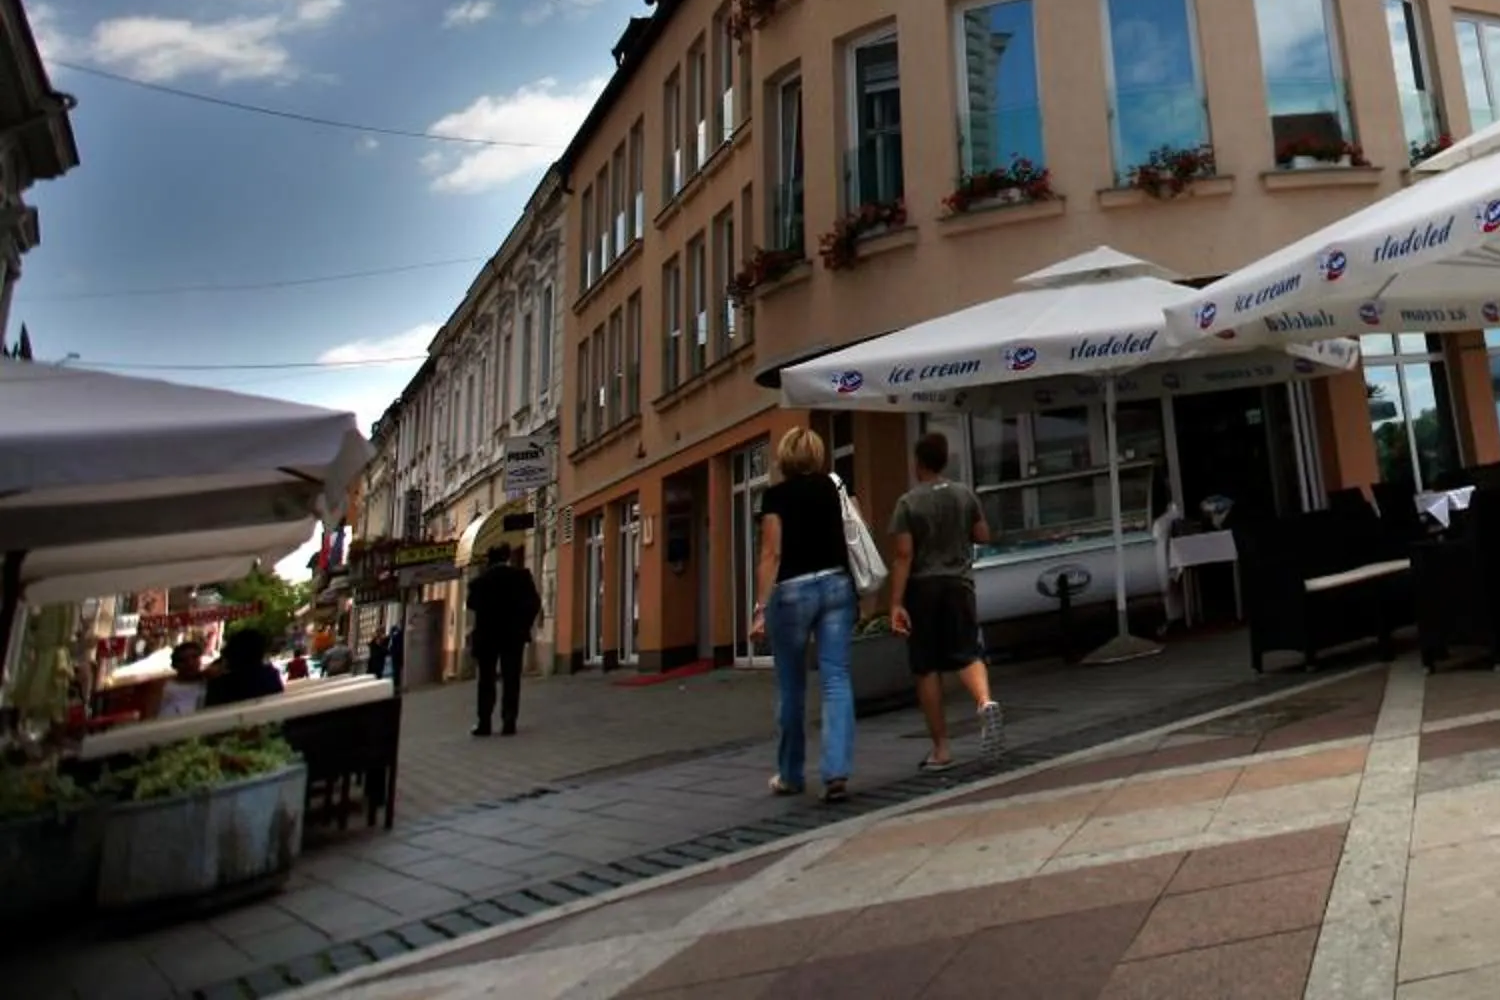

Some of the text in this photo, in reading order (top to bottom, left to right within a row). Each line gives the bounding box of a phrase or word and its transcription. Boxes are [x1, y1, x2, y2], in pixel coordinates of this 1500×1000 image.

[1373, 215, 1456, 264] sladoled
[1234, 273, 1302, 313] ice cream
[1069, 330, 1159, 361] sladoled
[887, 358, 981, 385] ice cream
